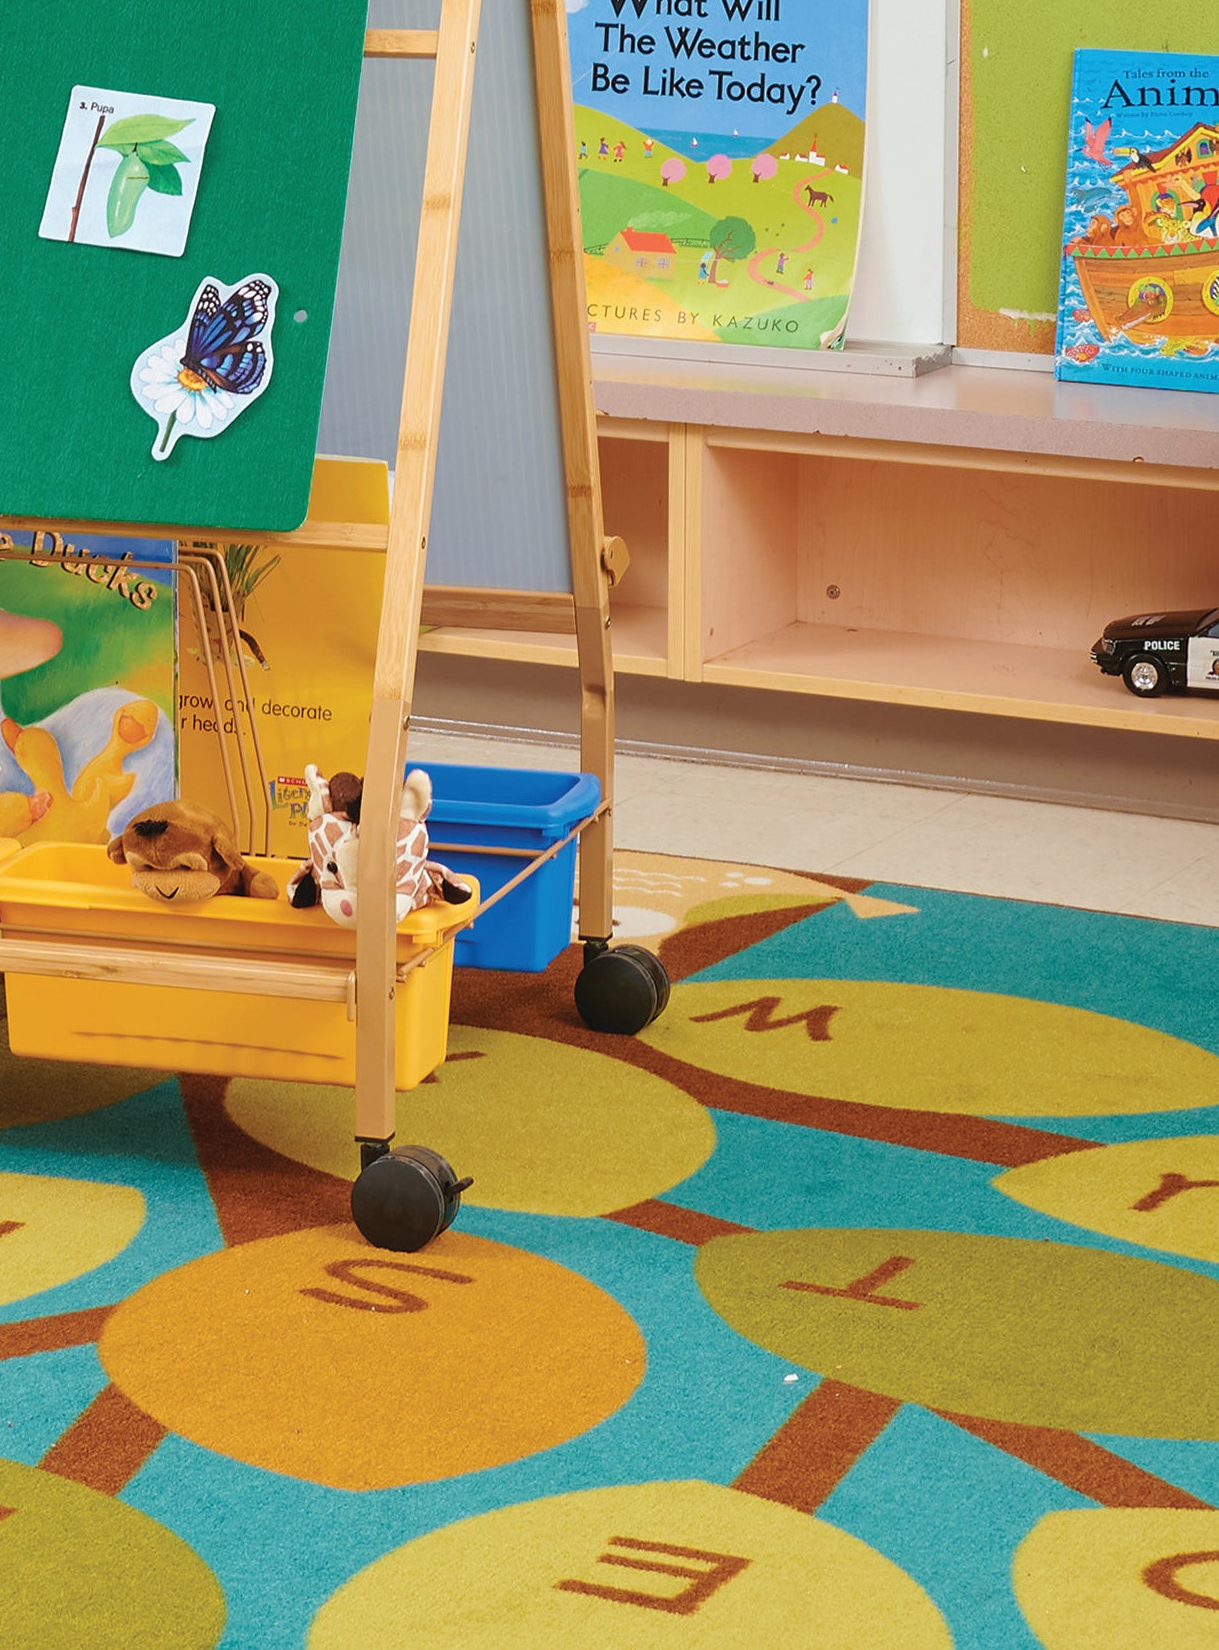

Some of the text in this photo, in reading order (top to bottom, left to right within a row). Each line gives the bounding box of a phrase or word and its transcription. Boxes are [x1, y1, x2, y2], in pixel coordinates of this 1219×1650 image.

[594, 21, 807, 64] The Weather
[591, 62, 822, 116] Be Like Today?
[1122, 66, 1209, 79] Tales from the
[79, 101, 115, 115] 3. Pupa
[586, 303, 800, 333] CTURES BY KAZUKO
[30, 529, 158, 610] Ducks
[1144, 640, 1181, 651] POLICE
[261, 699, 333, 721] decorate
[298, 1258, 474, 1315] S
[780, 1255, 923, 1311] T
[553, 1536, 754, 1616] E
